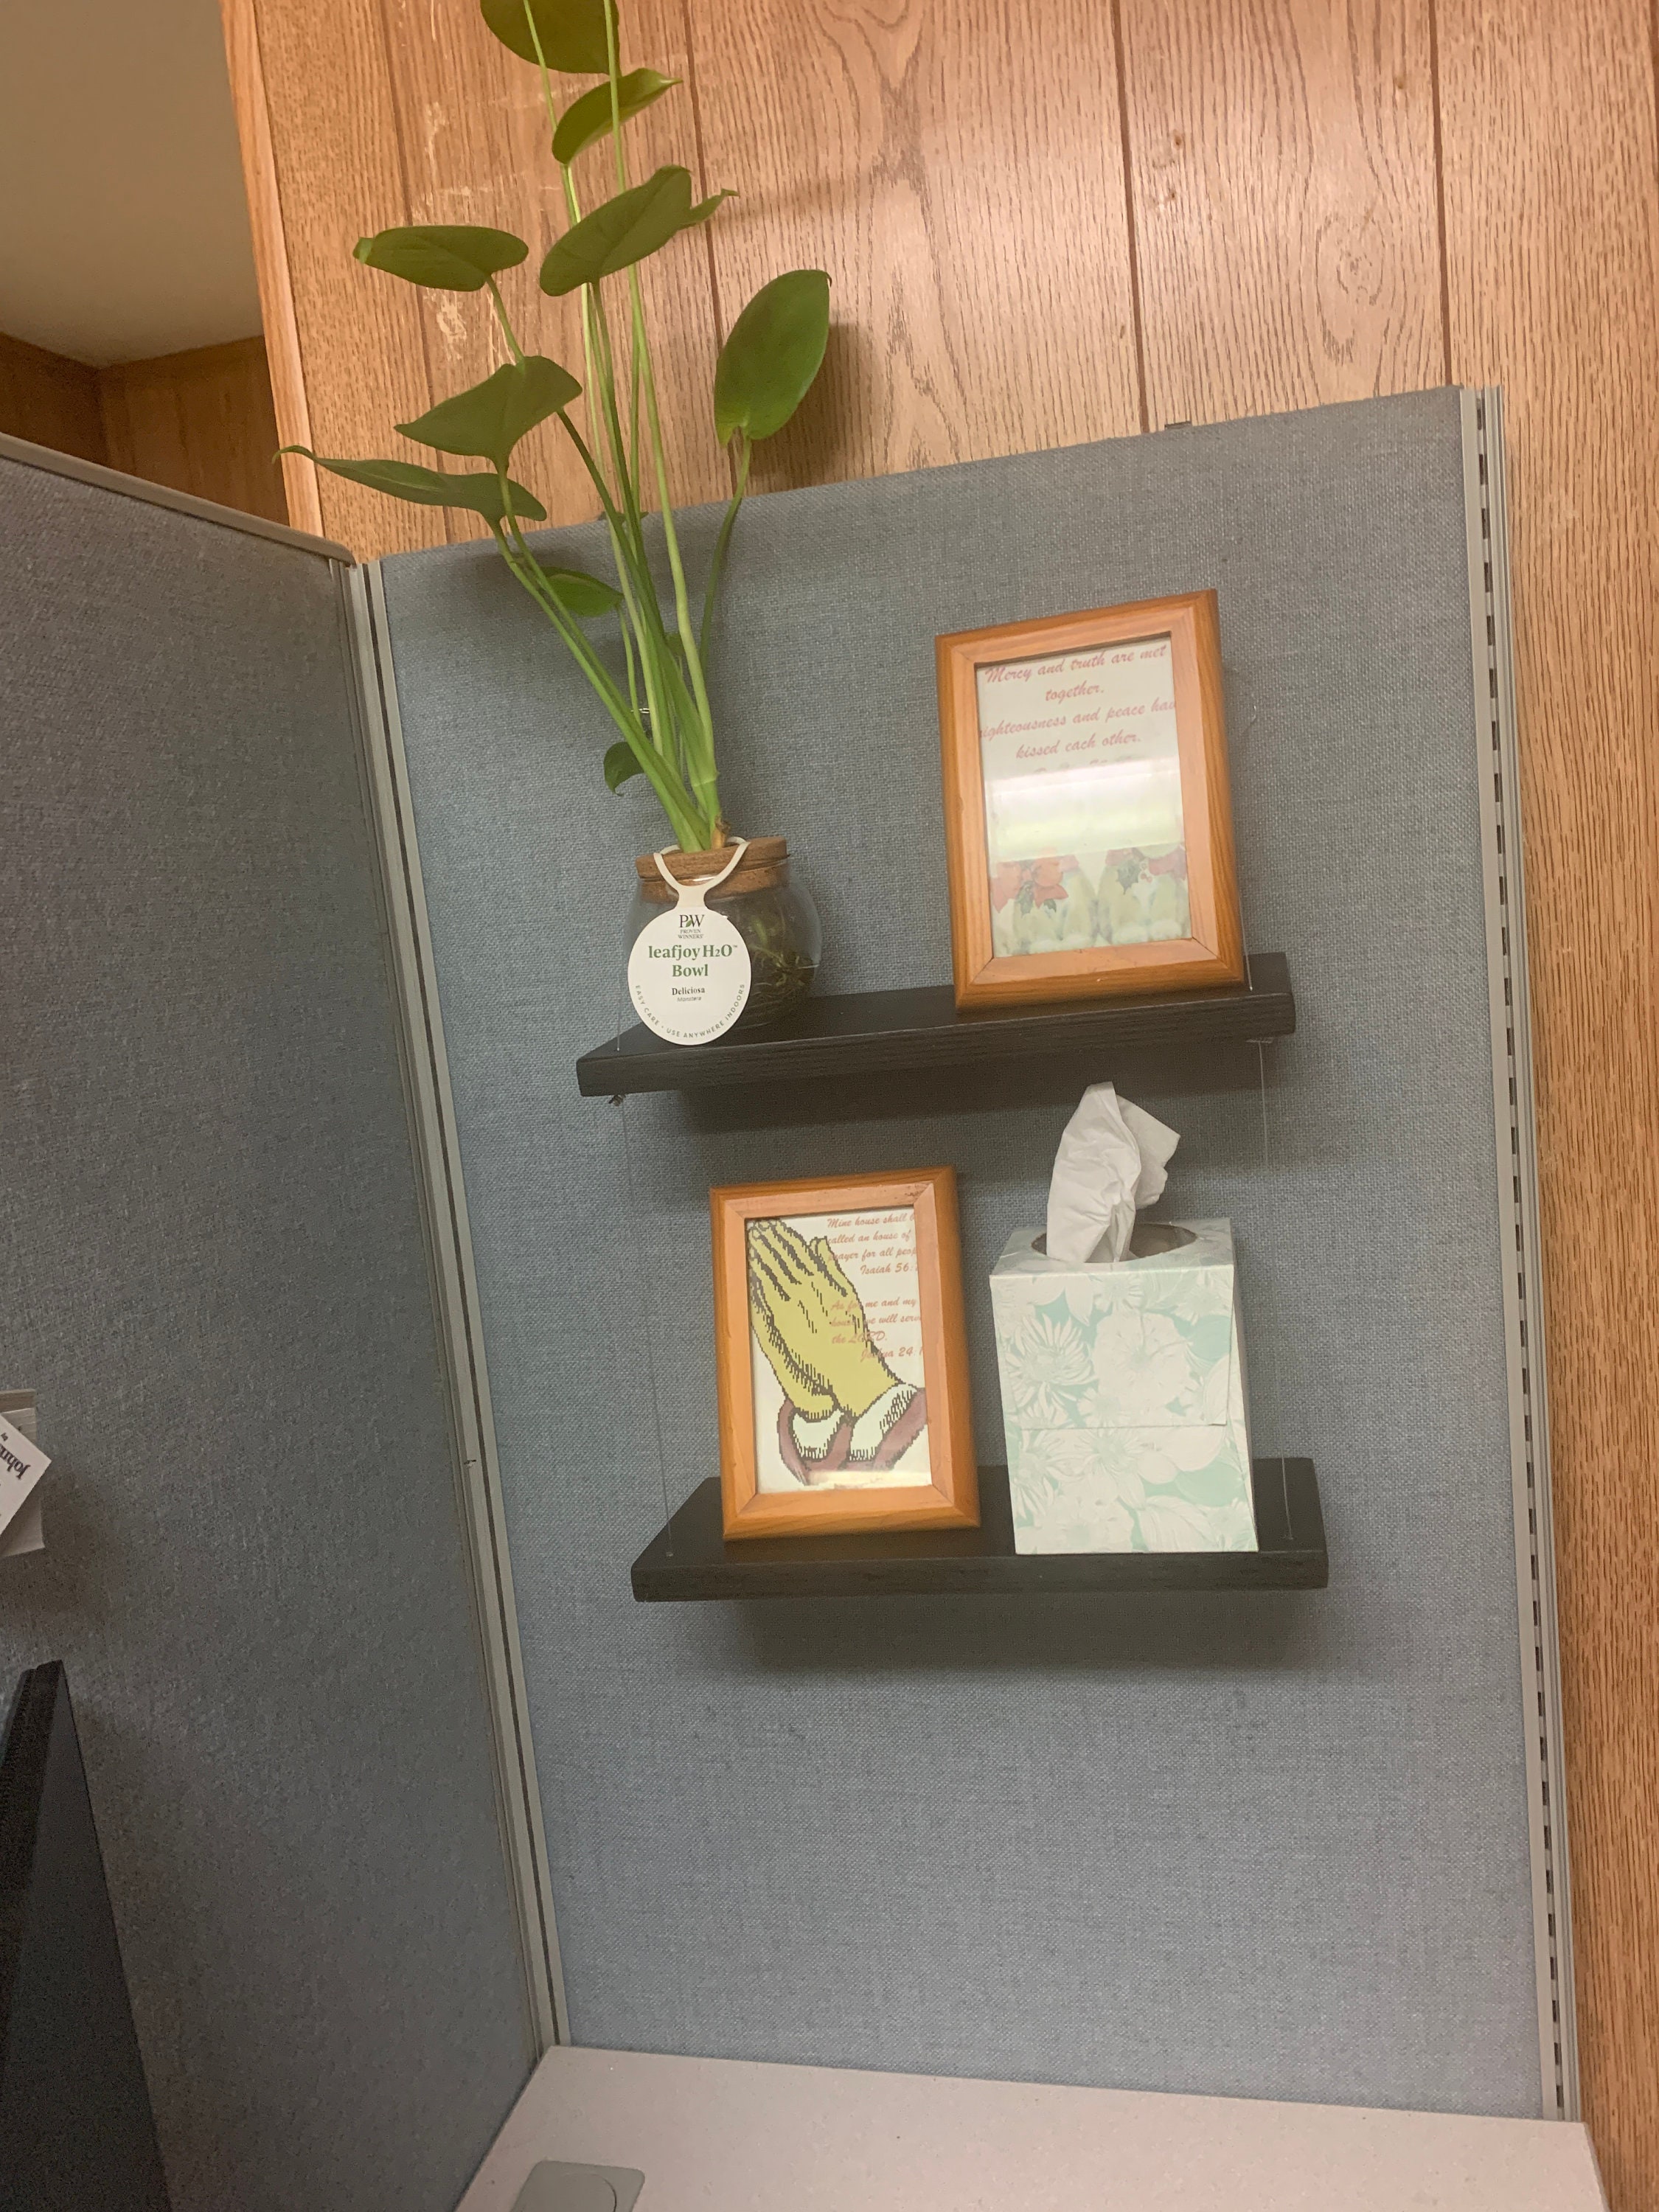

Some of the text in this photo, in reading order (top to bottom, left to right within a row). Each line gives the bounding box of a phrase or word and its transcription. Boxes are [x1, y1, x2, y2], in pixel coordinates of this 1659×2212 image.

[984, 644, 1167, 684] Mercy and truth are met
[1045, 680, 1105, 704] together.
[1072, 707, 1101, 724] and
[1105, 703, 1145, 723] peace
[1016, 729, 1141, 759] kissed each other.
[648, 945, 700, 961] leafjoy
[672, 964, 709, 978] Bowl
[672, 986, 706, 995] Deliciosa
[636, 984, 745, 1038] EASY CARE USE ANYWHERE INDOORS
[827, 1218, 852, 1228] Mine
[855, 1216, 880, 1225] house
[883, 1213, 908, 1224] shall
[827, 1234, 855, 1244] called
[873, 1231, 898, 1240] house
[901, 1229, 911, 1242] of
[861, 1249, 876, 1262] for
[879, 1247, 894, 1256] all
[860, 1263, 891, 1275] Isaiah
[881, 1296, 900, 1307] and
[902, 1298, 917, 1307] my
[878, 1313, 898, 1324] will
[832, 1333, 846, 1344] the
